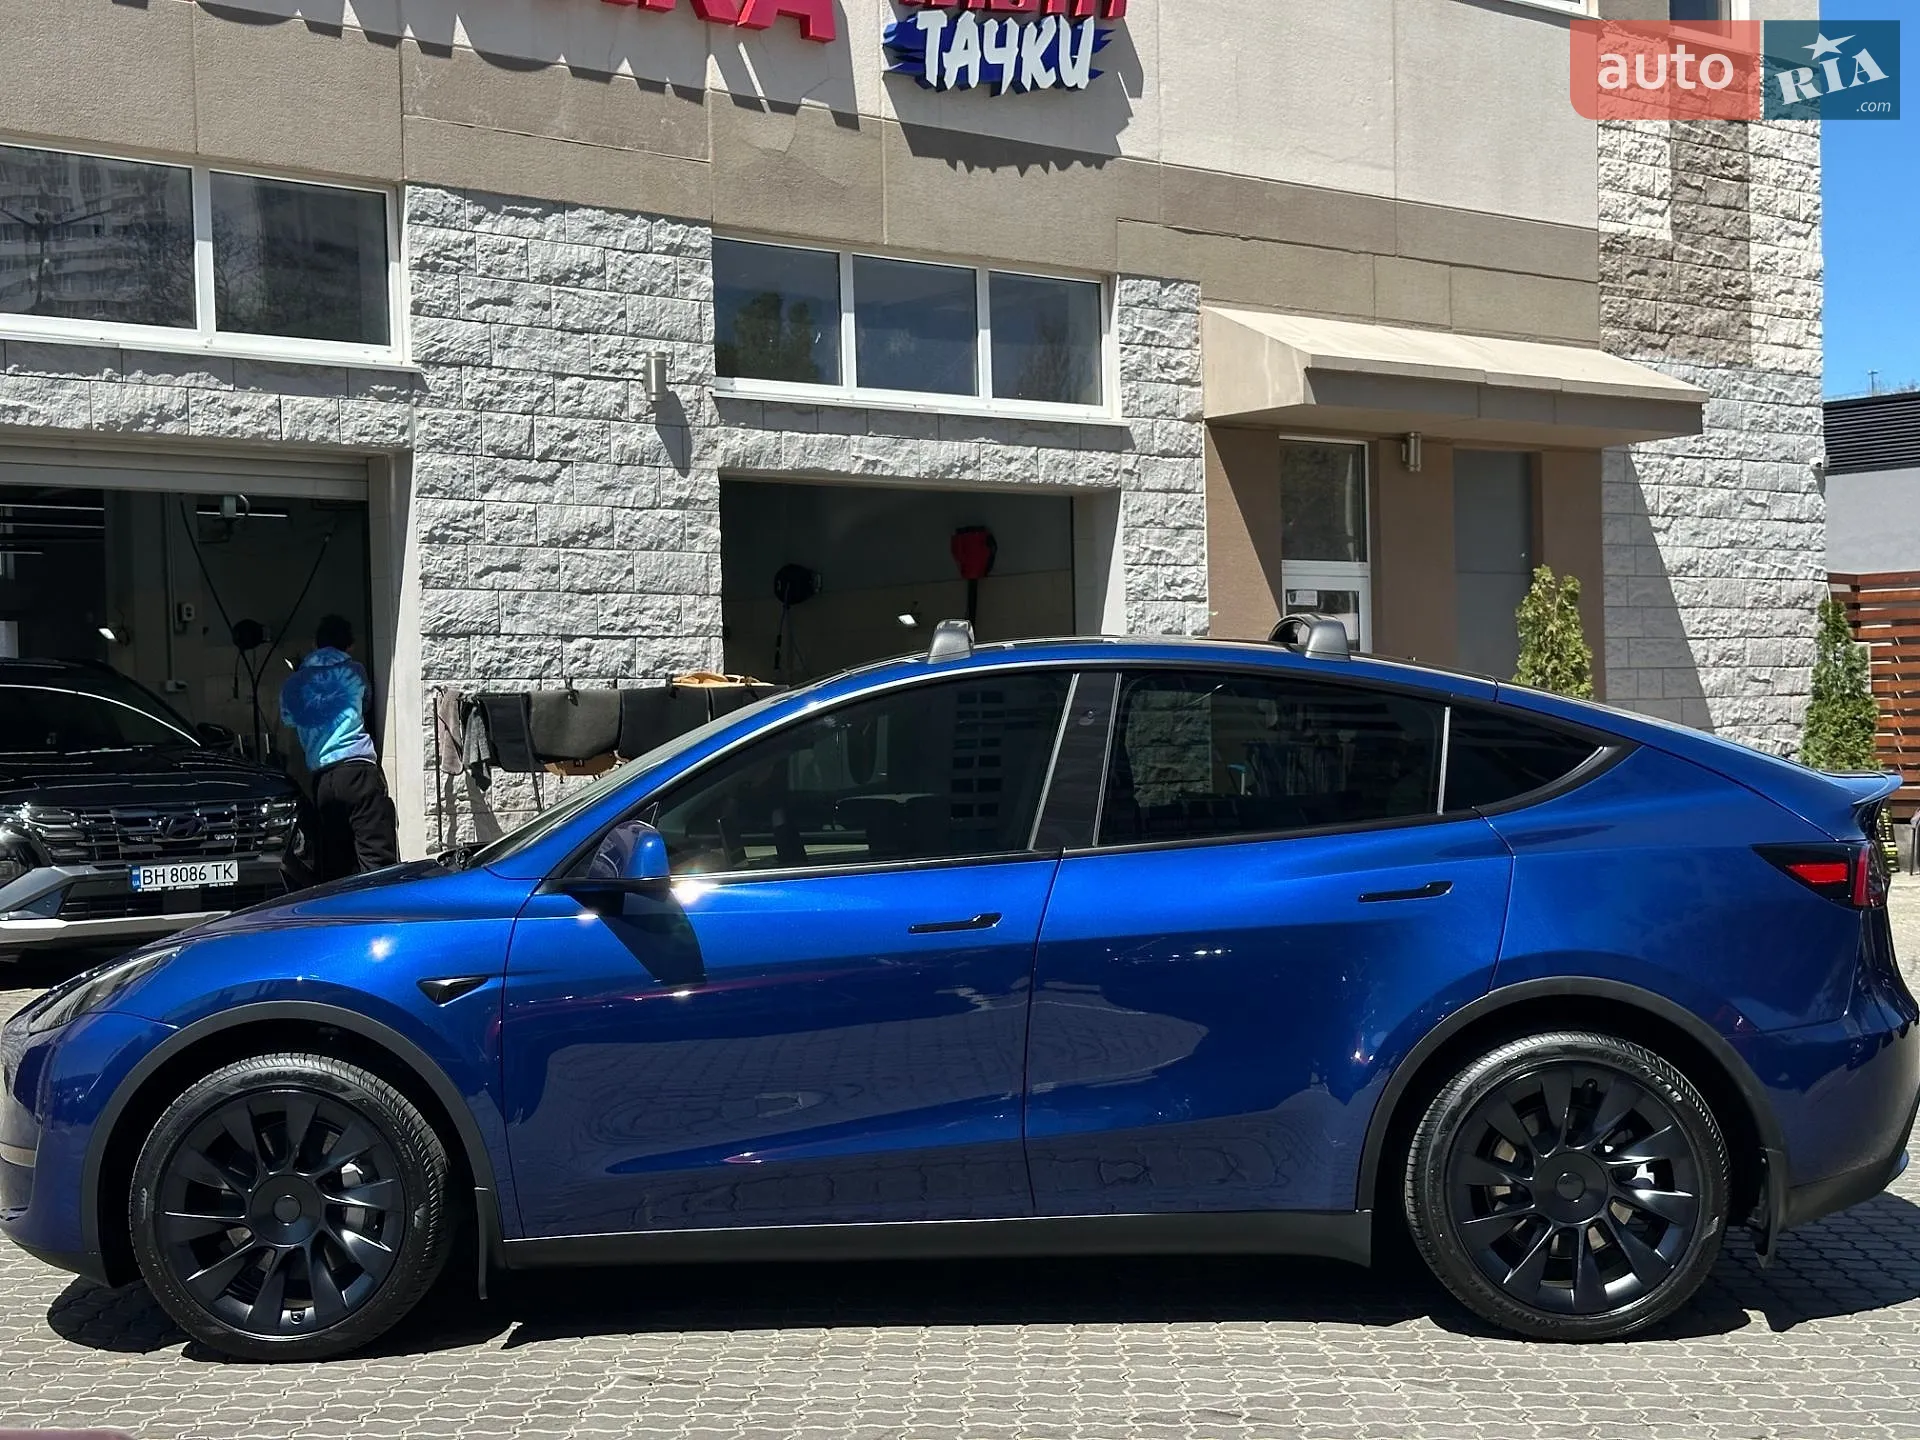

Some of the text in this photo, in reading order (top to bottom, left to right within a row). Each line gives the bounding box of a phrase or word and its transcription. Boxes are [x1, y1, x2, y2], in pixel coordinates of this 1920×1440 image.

[916, 9, 1096, 96] ТАЧКИ
[142, 862, 235, 885] BH 8086 TK
